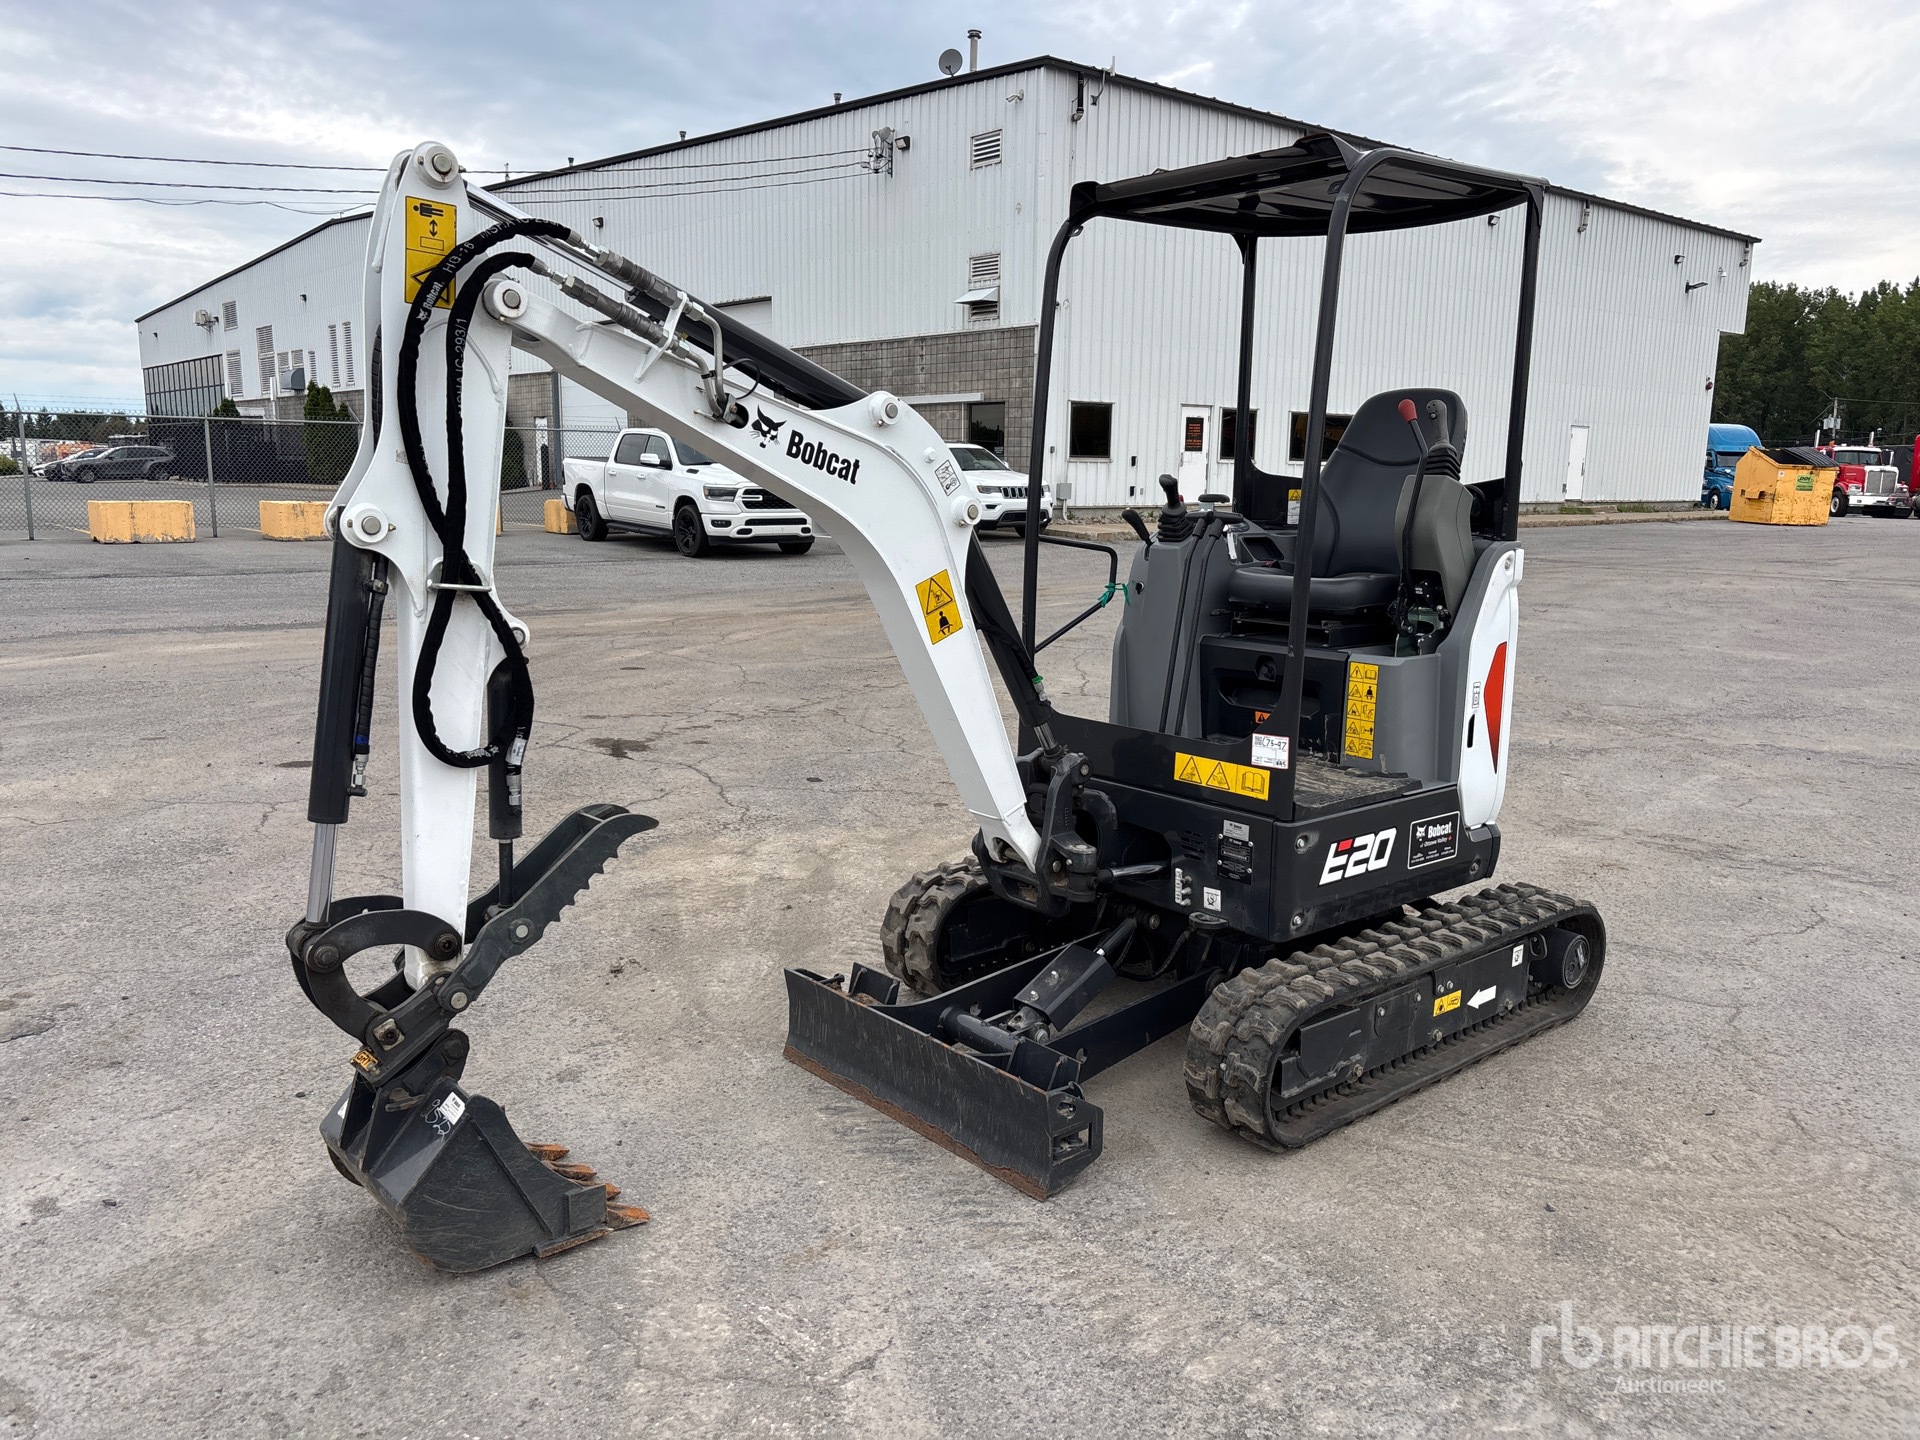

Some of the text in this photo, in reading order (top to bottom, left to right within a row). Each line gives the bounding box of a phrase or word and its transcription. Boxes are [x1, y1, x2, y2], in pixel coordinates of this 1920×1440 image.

[422, 281, 444, 310] Bobcat
[786, 429, 860, 485] Bobcat
[1427, 821, 1452, 838] Bobcat
[1319, 827, 1397, 886] E20
